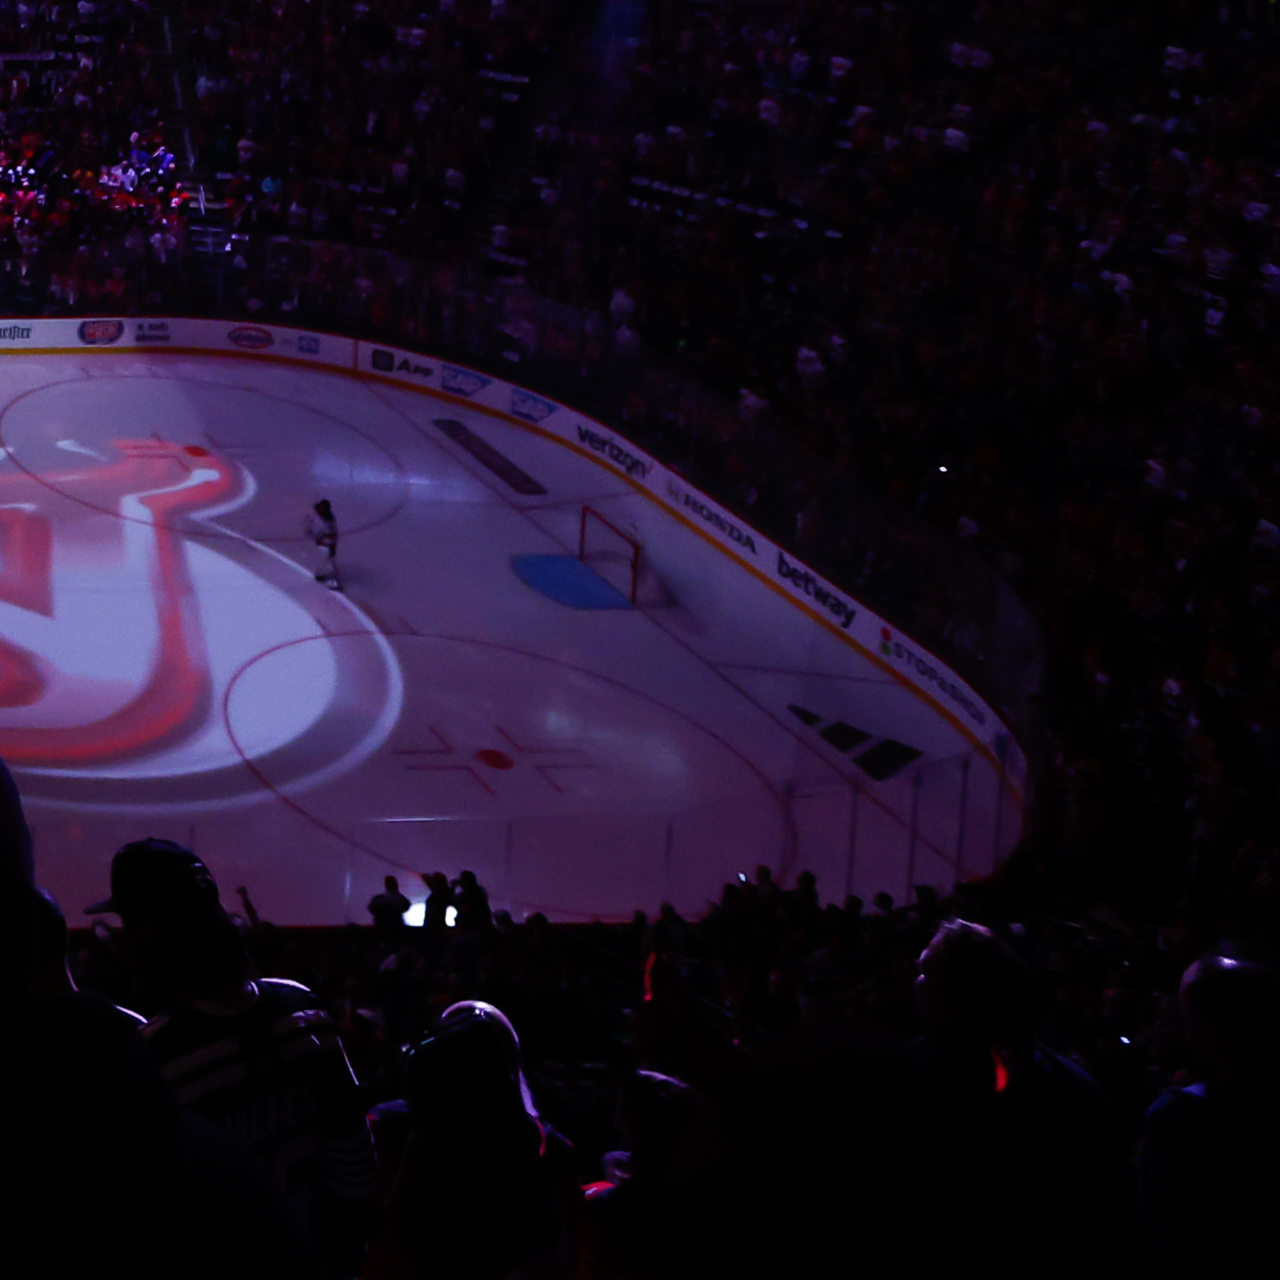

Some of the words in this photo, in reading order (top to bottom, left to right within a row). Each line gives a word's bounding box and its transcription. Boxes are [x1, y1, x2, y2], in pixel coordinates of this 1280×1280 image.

[576, 423, 646, 479] verizon
[683, 493, 757, 554] HONDA
[777, 551, 856, 629] betway
